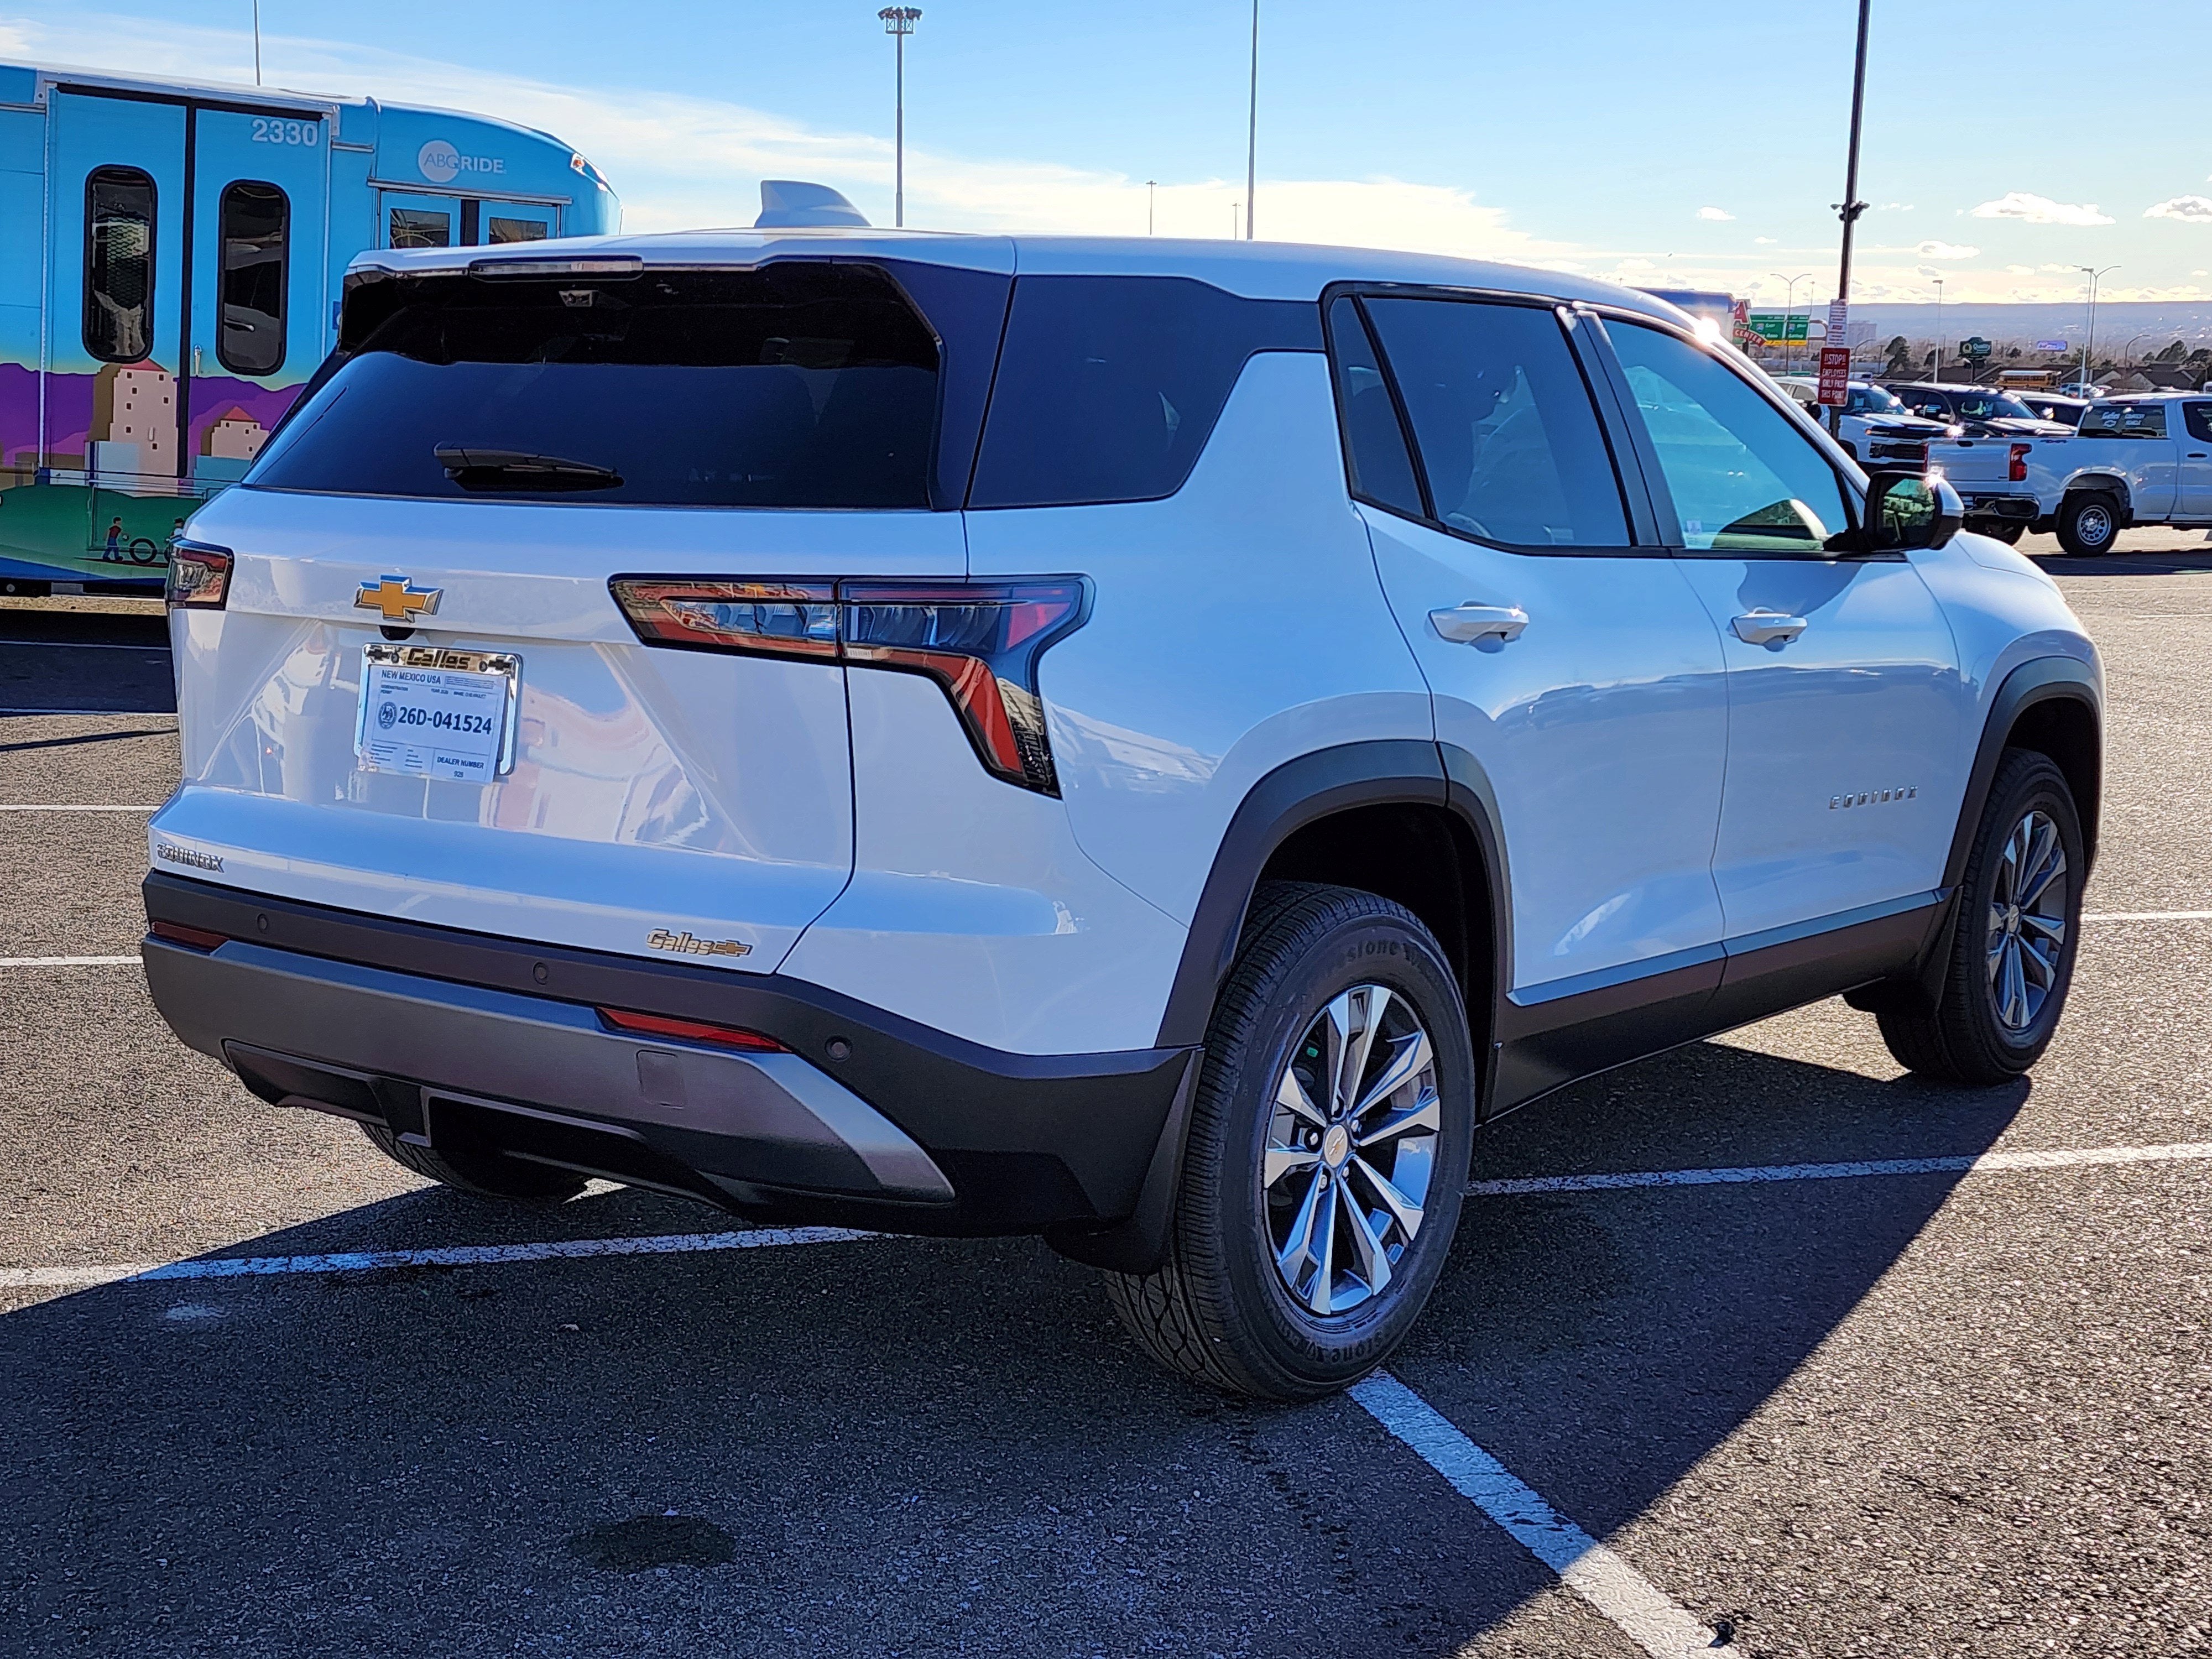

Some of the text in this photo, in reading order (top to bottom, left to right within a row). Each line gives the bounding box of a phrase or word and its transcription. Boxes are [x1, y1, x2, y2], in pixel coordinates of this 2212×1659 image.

[252, 118, 318, 147] 2330
[1734, 329, 1762, 346] CENTER
[406, 648, 471, 670] Galles
[382, 670, 398, 680] NEW
[399, 671, 425, 683] MEXICO
[426, 674, 441, 685] USA
[398, 707, 492, 734] 26D-041524
[437, 757, 484, 769] DEALER NUMBER
[647, 928, 714, 956] Galles
